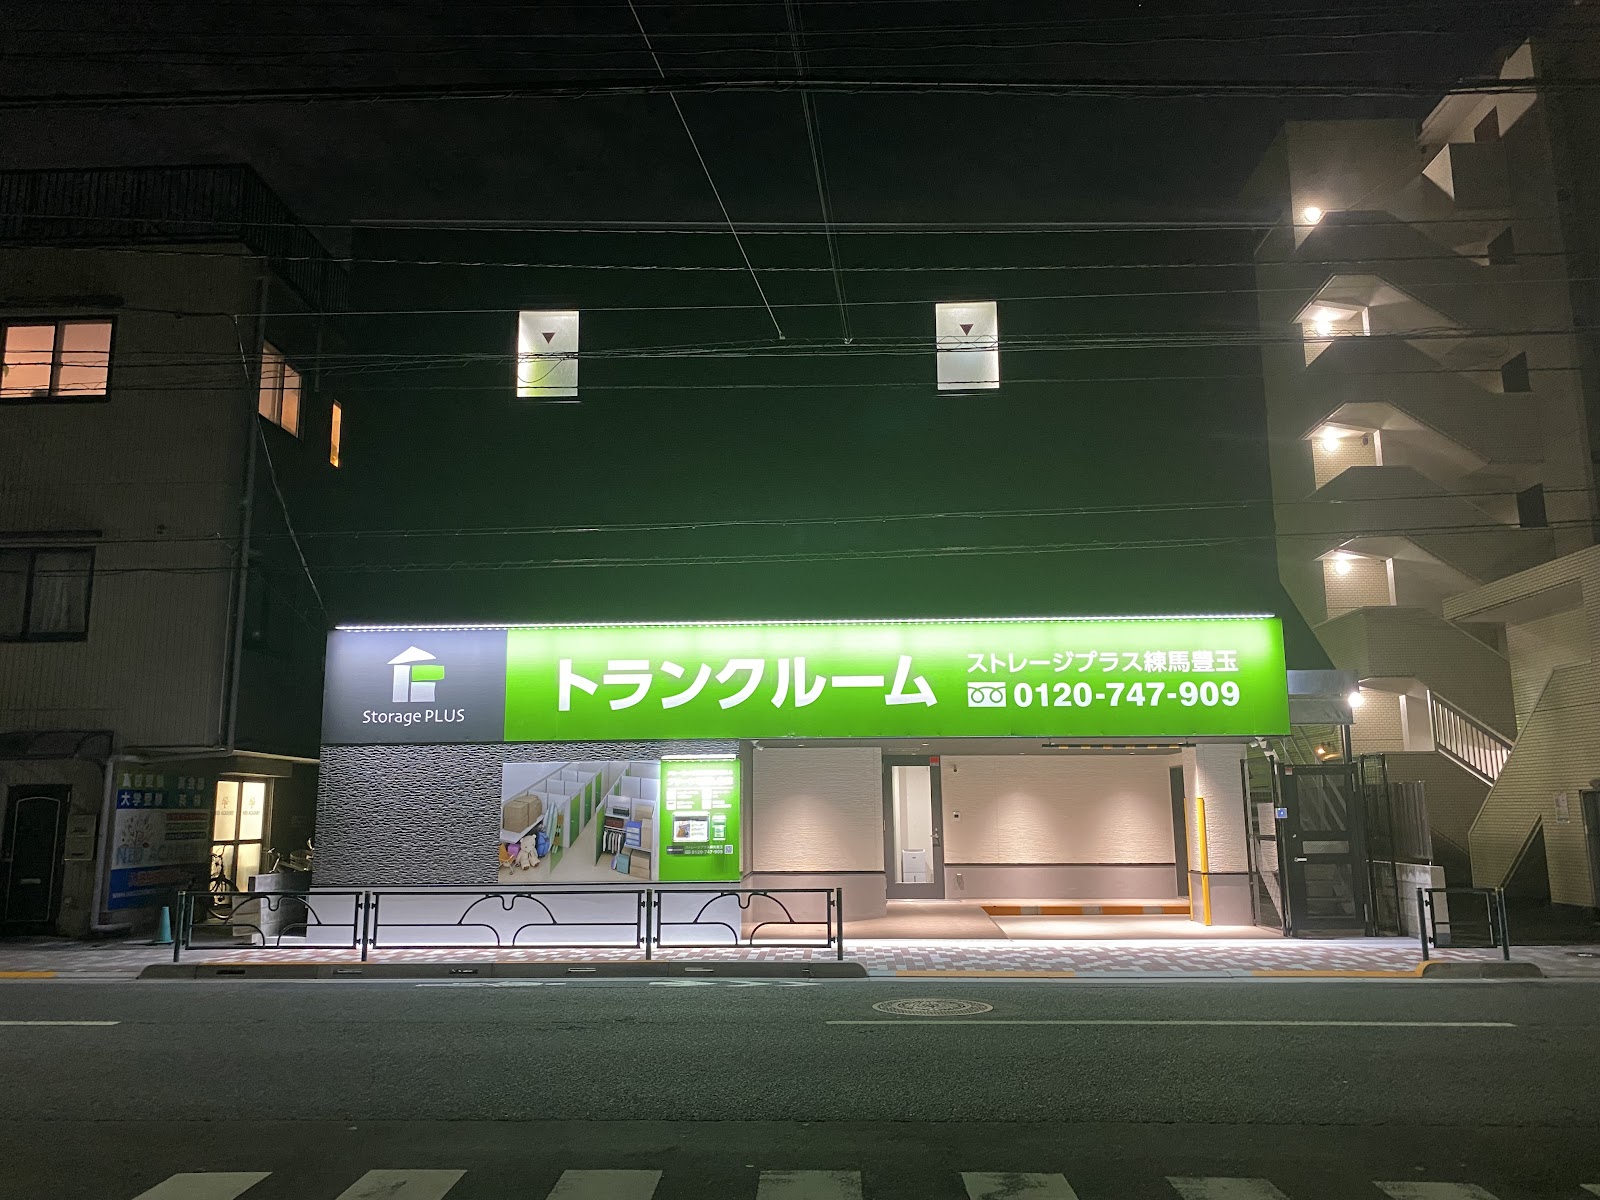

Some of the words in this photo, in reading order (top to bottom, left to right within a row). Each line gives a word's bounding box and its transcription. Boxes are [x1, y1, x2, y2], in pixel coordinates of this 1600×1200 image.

[967, 650, 1239, 674] ストレージプラス練馬豊玉
[557, 655, 938, 712] トランクルーム
[1013, 681, 1241, 708] 0120-747-909
[362, 709, 421, 727] Storage
[425, 709, 466, 724] PLUS
